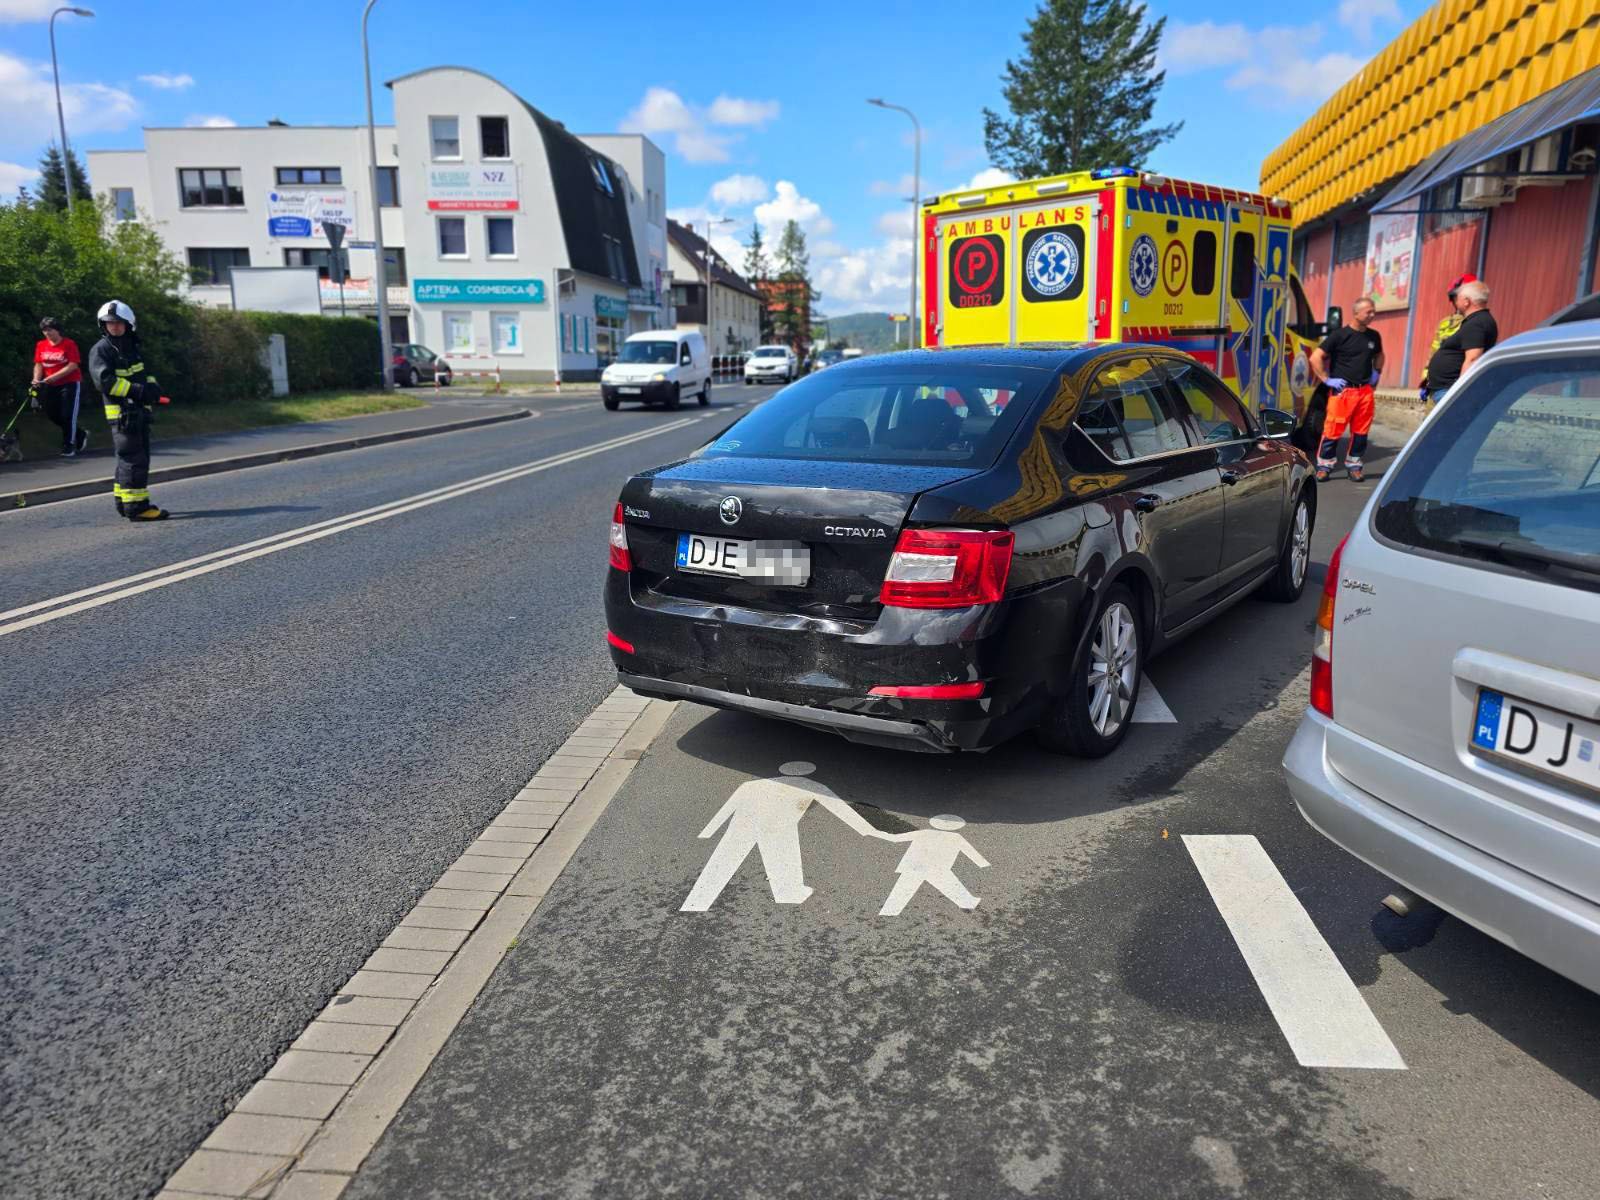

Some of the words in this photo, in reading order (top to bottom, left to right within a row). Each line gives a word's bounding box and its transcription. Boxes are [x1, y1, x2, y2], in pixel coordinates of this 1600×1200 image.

[948, 206, 1084, 238] AMBULANS
[968, 251, 986, 280] P
[1171, 254, 1182, 283] P
[418, 284, 460, 294] APTEKA
[466, 284, 525, 294] COSMEDICA
[824, 525, 887, 538] OCTAVIA
[679, 552, 687, 561] PL
[1478, 725, 1494, 741] PL
